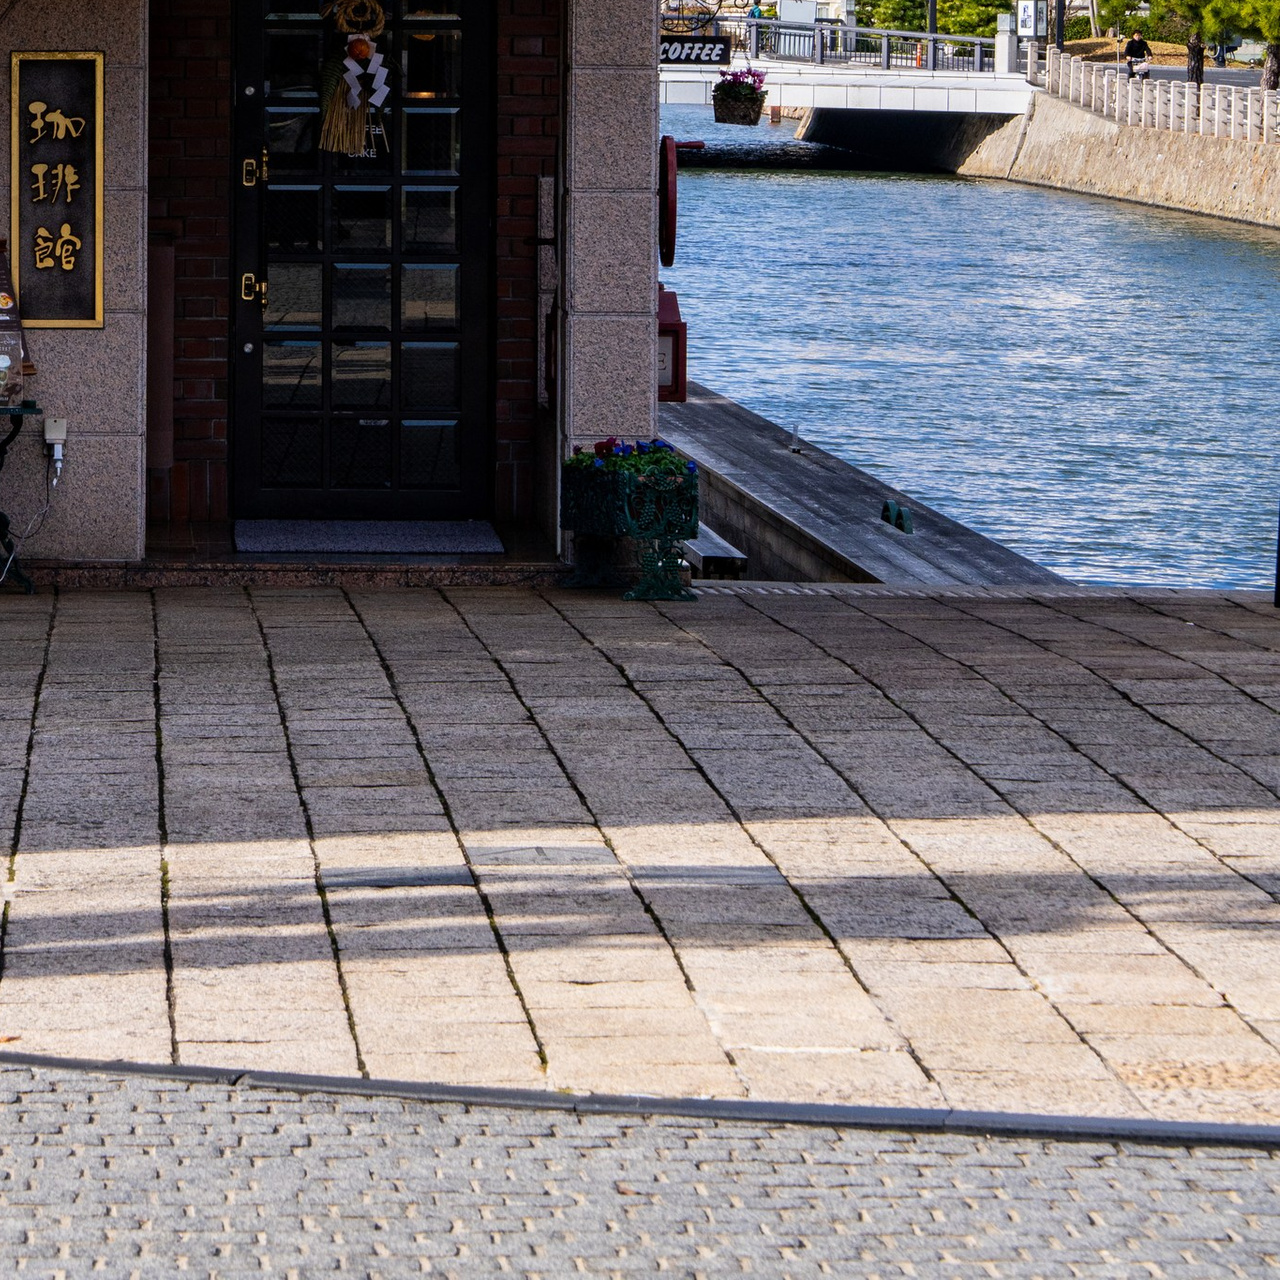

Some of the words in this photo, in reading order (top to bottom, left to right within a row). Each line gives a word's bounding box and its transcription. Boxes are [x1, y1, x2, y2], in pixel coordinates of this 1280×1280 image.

[659, 42, 724, 61] COFFEE
[28, 101, 86, 271] 珈琲館
